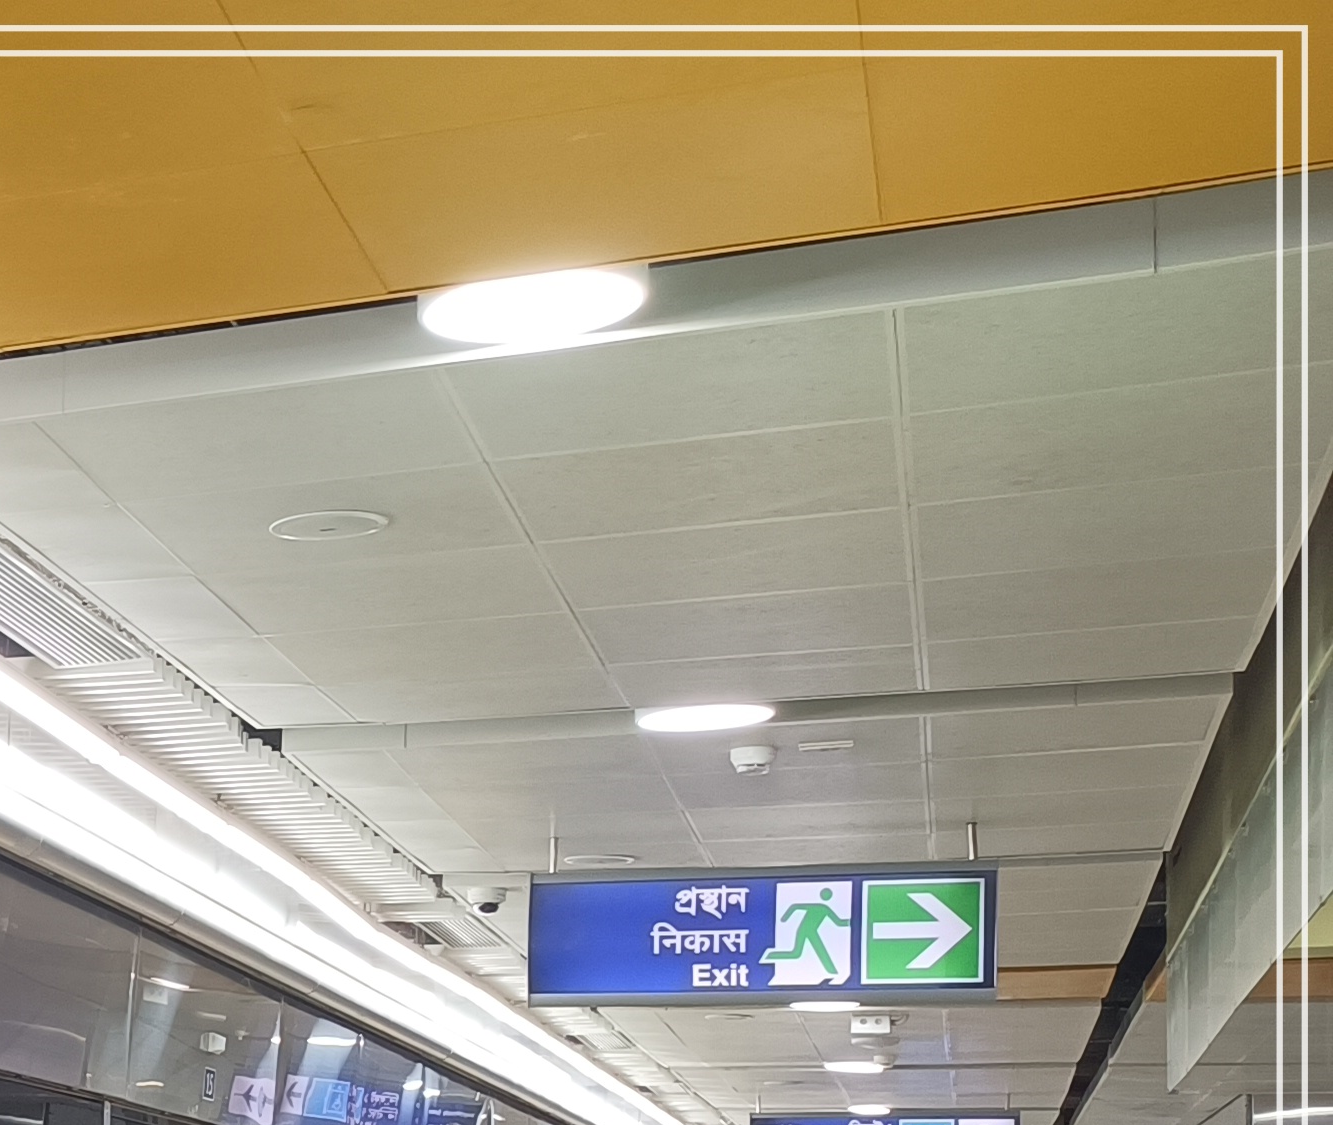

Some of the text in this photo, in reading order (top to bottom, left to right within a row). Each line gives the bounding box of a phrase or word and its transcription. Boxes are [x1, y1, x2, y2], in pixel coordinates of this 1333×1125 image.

[674, 884, 750, 920] প্রস্থান
[649, 921, 750, 955] निकास
[691, 963, 750, 988] Exit
